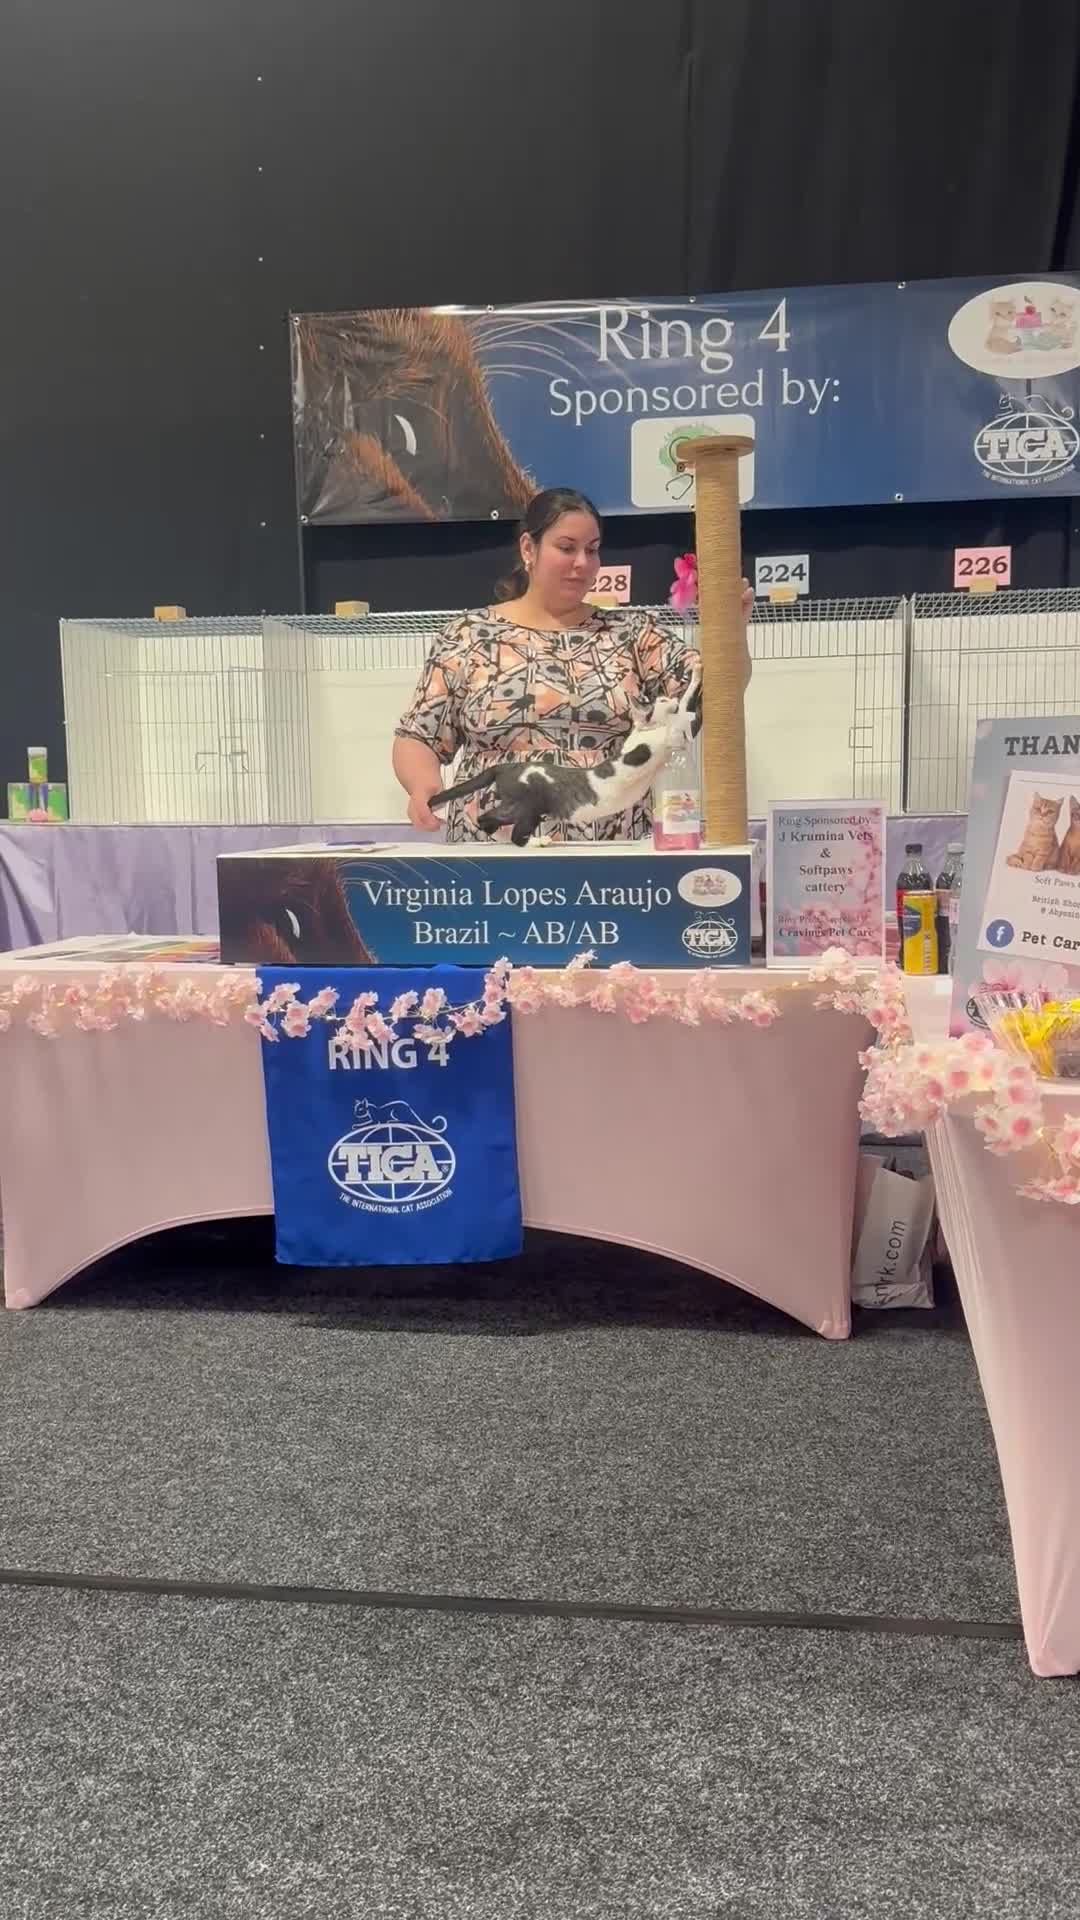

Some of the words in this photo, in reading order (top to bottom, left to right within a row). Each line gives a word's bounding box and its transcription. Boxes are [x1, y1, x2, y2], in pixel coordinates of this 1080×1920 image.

[598, 308, 735, 374] Ring
[757, 297, 791, 353] 4
[549, 369, 764, 426] Sponsored
[781, 368, 841, 415] by:
[983, 430, 1069, 460] TICA
[758, 563, 807, 584] 224
[958, 555, 1008, 576] 226
[1004, 734, 1080, 756] THAN
[779, 816, 801, 828] Ring
[804, 816, 858, 828] Sponsored
[859, 815, 872, 827] by
[779, 832, 786, 842] J
[791, 831, 845, 842] Krumina
[848, 831, 874, 841] Vets
[820, 848, 832, 859] &
[799, 864, 854, 878] Softpaws
[362, 879, 474, 913] Virginia
[483, 880, 566, 912] Lopes
[576, 880, 672, 913] Araujo
[805, 883, 847, 895] cattery
[413, 920, 489, 946] Brazil
[523, 920, 620, 946] AB/AB
[687, 928, 732, 947] TICA
[1022, 931, 1048, 946] Pet
[328, 1038, 418, 1070] RING
[427, 1040, 450, 1067] 4
[338, 1143, 443, 1183] TICA
[401, 1204, 414, 1213] CAT
